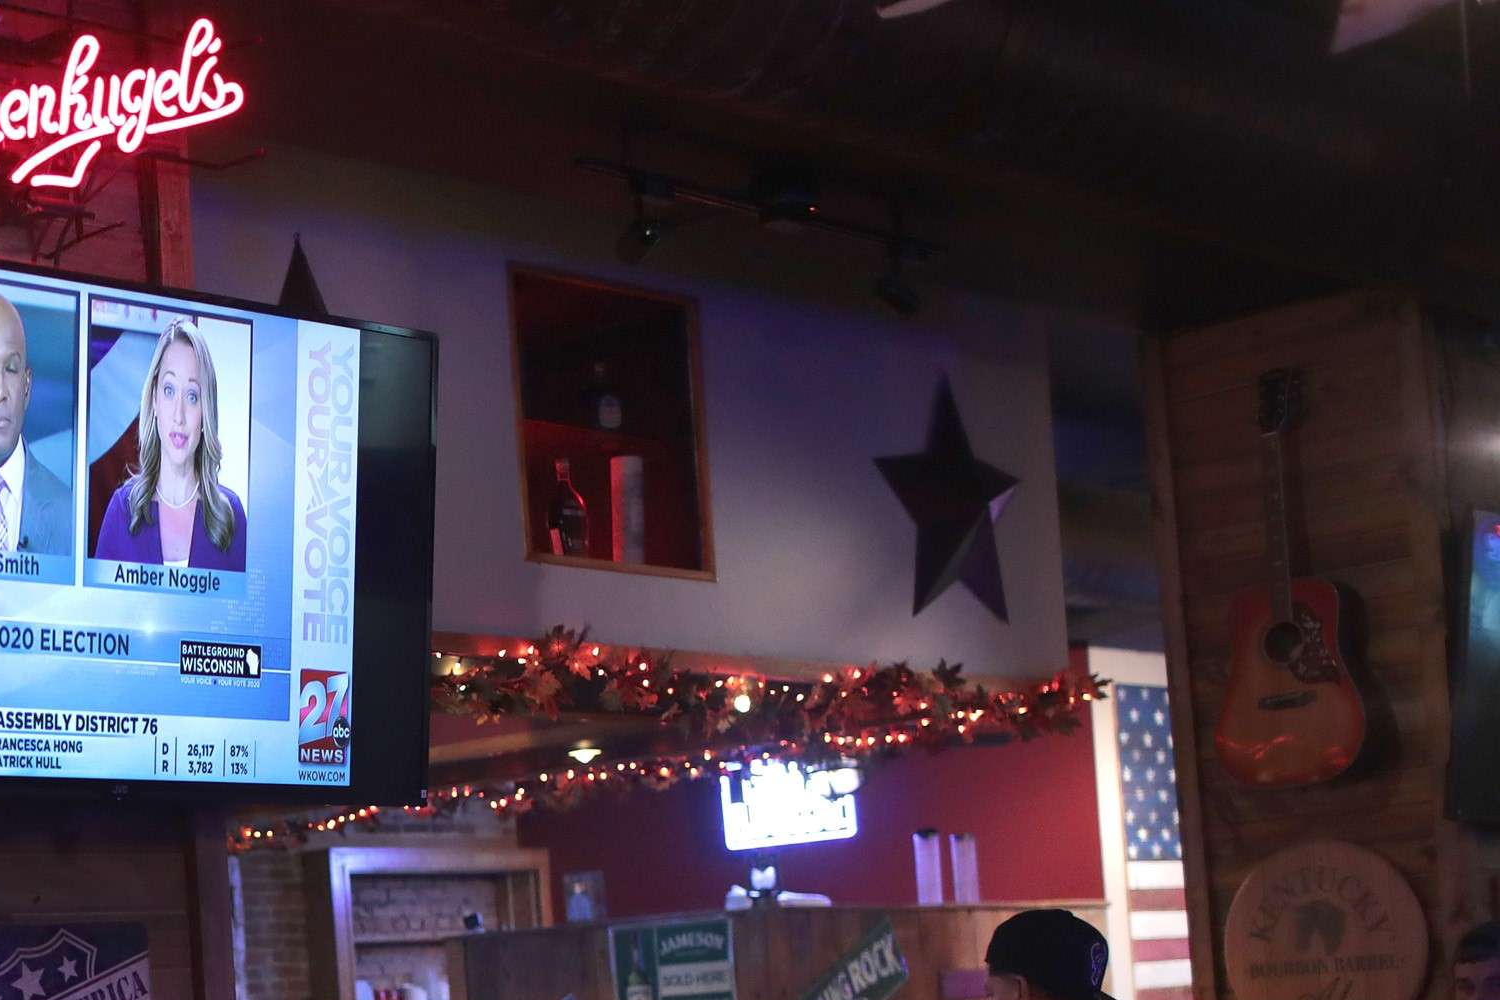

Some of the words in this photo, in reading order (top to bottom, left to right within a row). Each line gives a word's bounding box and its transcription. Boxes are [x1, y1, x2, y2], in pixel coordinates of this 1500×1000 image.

[114, 564, 164, 587] Amber
[168, 571, 221, 593] Noggle
[40, 629, 130, 656] ELECTION
[181, 644, 245, 658] BATTLEGROUND
[181, 658, 245, 675] WISCONSIN
[298, 673, 349, 745] 27
[75, 714, 138, 734] DISTRICT
[142, 718, 158, 735] 76
[332, 724, 350, 739] abc
[53, 740, 83, 753] HONG
[162, 743, 169, 755] D
[187, 744, 215, 757] 26,117
[230, 745, 248, 757] 87%
[36, 757, 62, 769] HULL
[300, 748, 344, 763] NEWS
[162, 760, 169, 772] R
[188, 761, 213, 774] 3,782
[231, 762, 248, 775] 13%
[299, 770, 346, 783] WKOW.COM
[1250, 864, 1395, 942] KENTUCKY
[846, 933, 902, 994] ROCK
